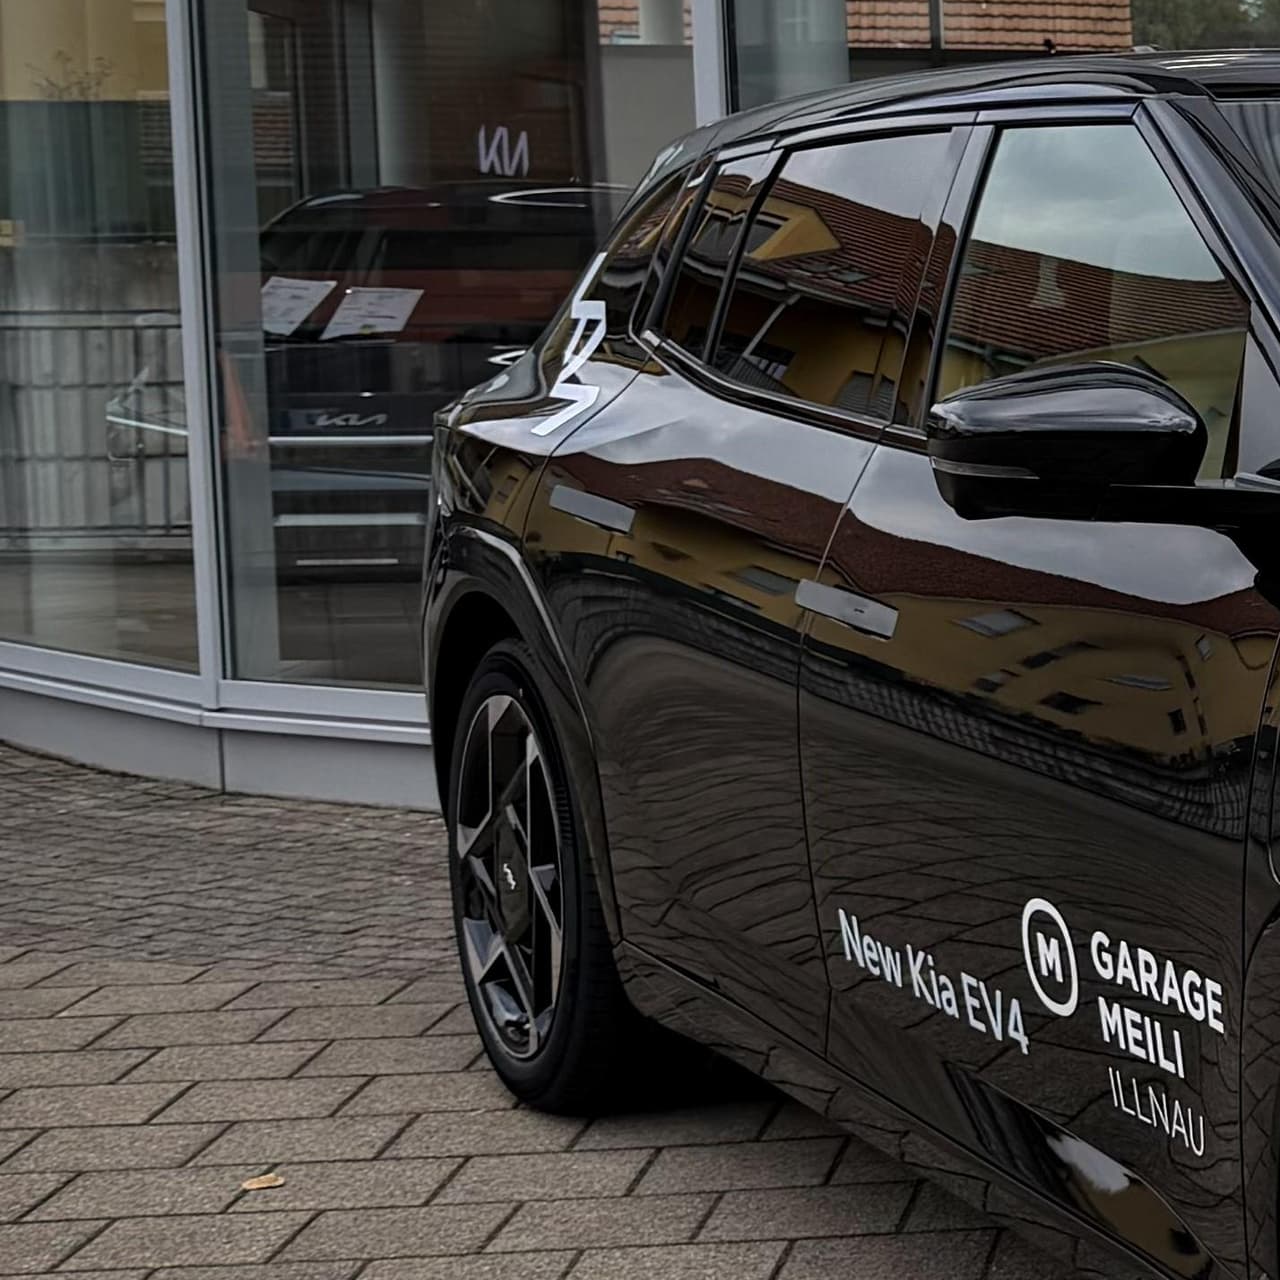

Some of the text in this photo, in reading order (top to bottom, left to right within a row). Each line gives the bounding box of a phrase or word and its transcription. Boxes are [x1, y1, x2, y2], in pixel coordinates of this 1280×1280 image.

[478, 124, 529, 177] KIA
[316, 413, 388, 427] KIA
[838, 908, 1029, 1055] New Kia EV4
[1091, 931, 1225, 1034] GARAGE
[1098, 996, 1185, 1078] MEILI
[1108, 1066, 1204, 1157] ILLNAU
